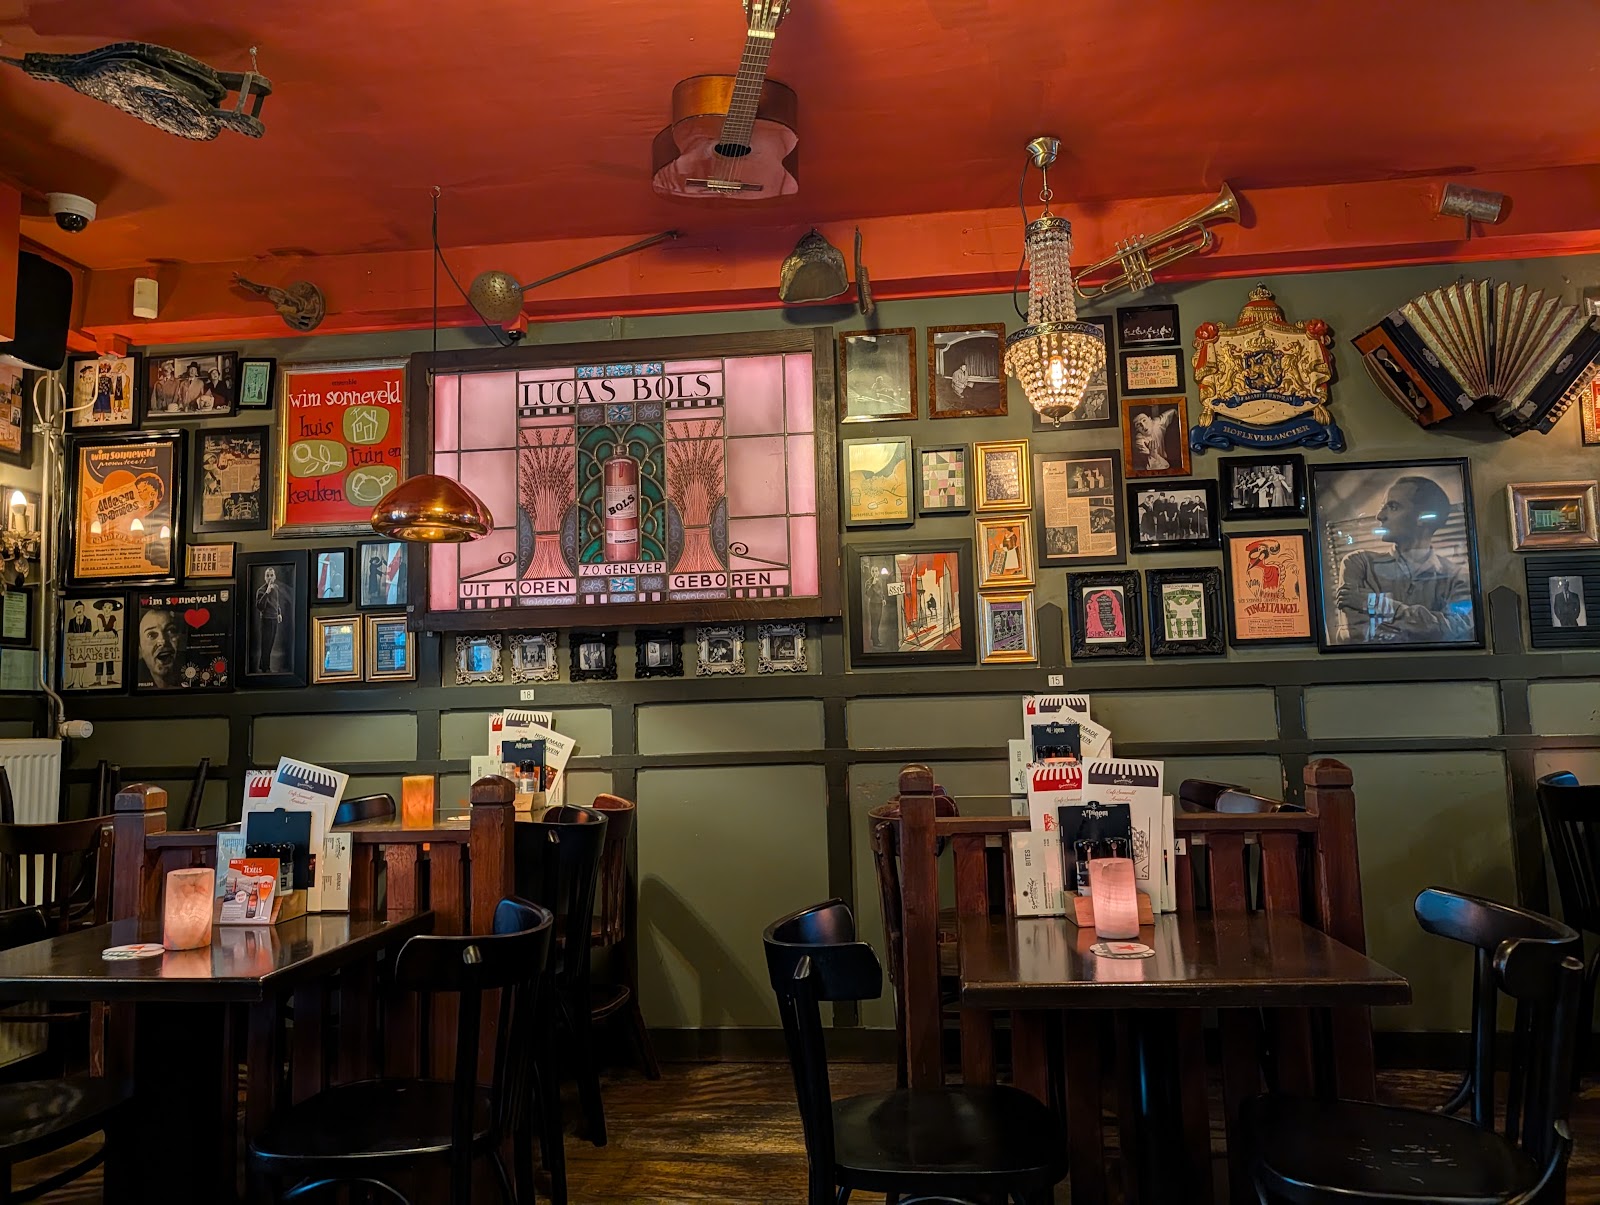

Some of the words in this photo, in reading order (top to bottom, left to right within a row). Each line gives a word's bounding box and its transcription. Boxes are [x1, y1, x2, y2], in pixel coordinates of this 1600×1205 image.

[289, 389, 322, 408] wim
[325, 380, 402, 406] sonneveld
[522, 379, 616, 406] LUCAS
[632, 374, 712, 401] BOLS
[299, 414, 334, 437] huis
[1223, 425, 1311, 441] HOFLEVERANCIER
[90, 449, 110, 461] wim
[110, 448, 156, 460] sonneveld
[350, 446, 384, 466] tuin
[388, 446, 402, 457] en
[287, 479, 344, 504] keuken
[608, 494, 635, 515] BOLS
[193, 553, 216, 562] VERRE
[192, 562, 216, 571] REIZEN
[604, 562, 662, 575] GENEVER
[463, 583, 490, 596] UIT
[504, 580, 571, 595] KOREN
[674, 572, 771, 588] GEBOREN
[1050, 676, 1061, 685] 15
[523, 691, 531, 699] 18
[1024, 849, 1032, 866] BITES
